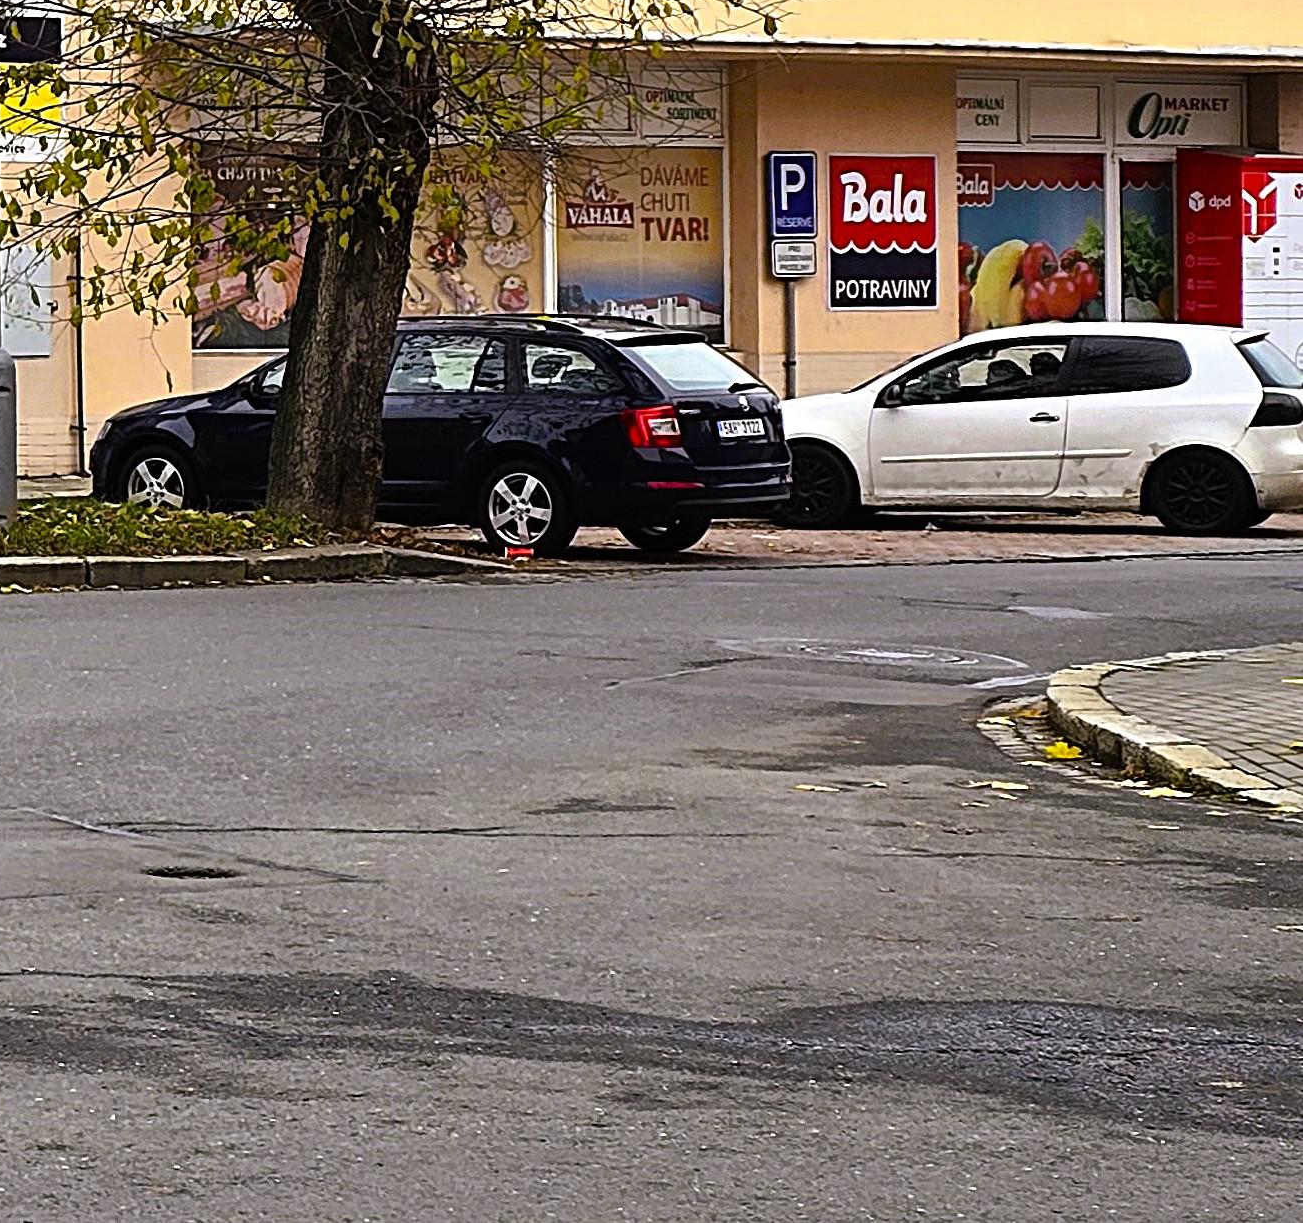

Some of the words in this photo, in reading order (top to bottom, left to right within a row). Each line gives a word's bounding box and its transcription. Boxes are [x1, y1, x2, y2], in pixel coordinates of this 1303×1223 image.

[1164, 96, 1230, 112] MARKET
[975, 113, 1000, 127] CENY
[1127, 91, 1191, 140] Opti
[640, 163, 709, 187] DÁVÁME
[780, 163, 806, 211] P
[640, 192, 690, 212] CHUTI
[839, 172, 928, 223] Bala
[1209, 195, 1232, 211] dpd
[568, 205, 633, 225] VÁHALA
[640, 217, 710, 242] TVAR!
[835, 279, 932, 299] POTRAVINY
